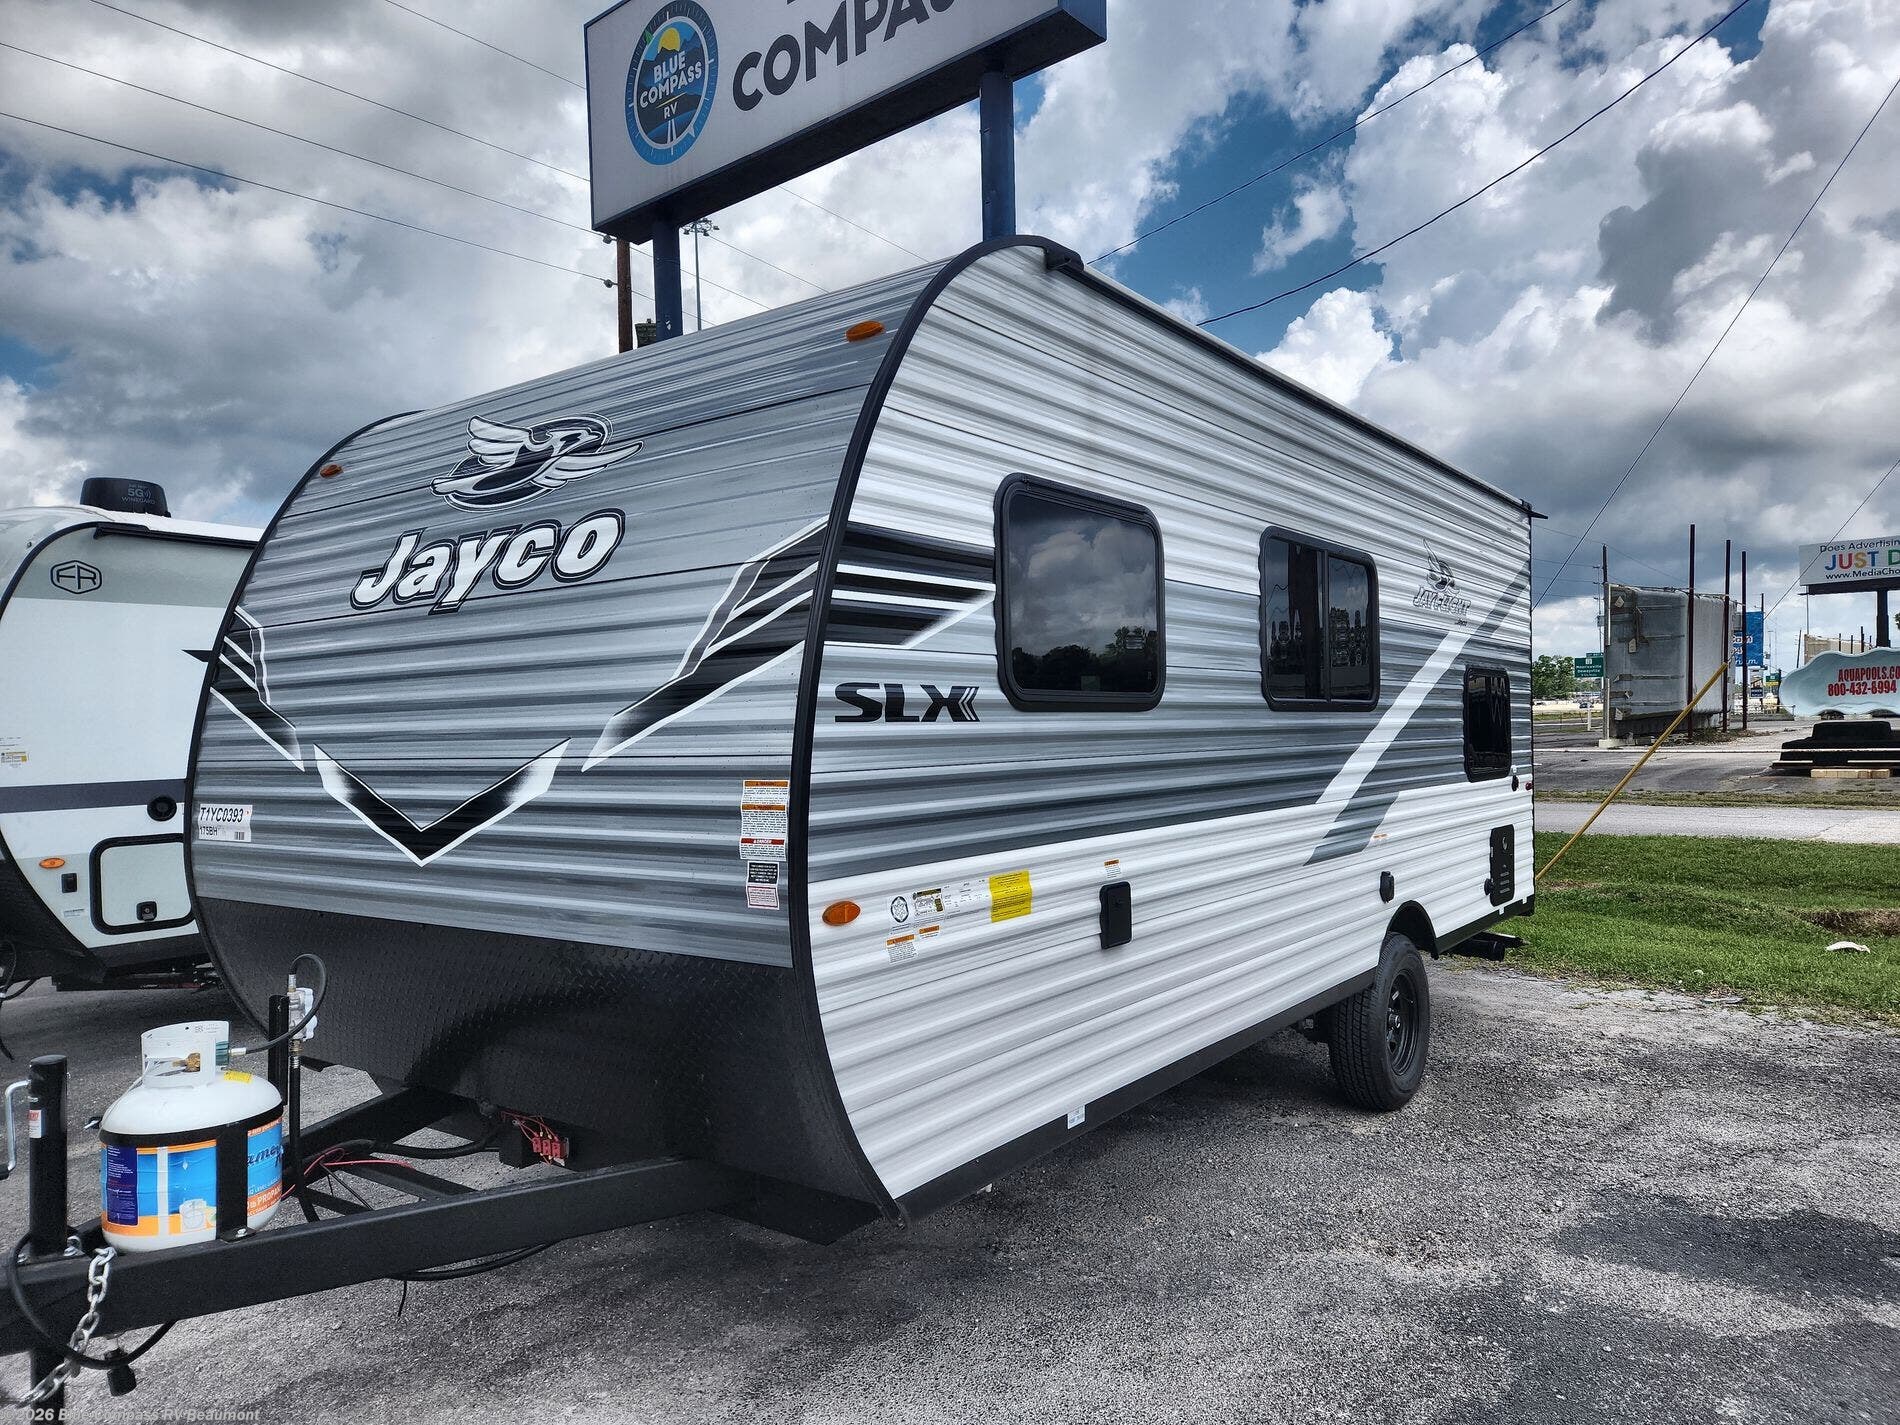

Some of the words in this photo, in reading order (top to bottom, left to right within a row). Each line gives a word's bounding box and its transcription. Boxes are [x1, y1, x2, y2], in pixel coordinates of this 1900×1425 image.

[653, 50, 686, 84] BLUE
[732, 0, 955, 111] COMPA
[640, 61, 702, 108] COMPASS
[663, 101, 678, 119] RV
[350, 508, 626, 615] Jayco
[1820, 544, 1845, 553] Does
[1824, 551, 1879, 571] JUST
[834, 682, 981, 722] SLX
[200, 807, 244, 823] T1YC0393
